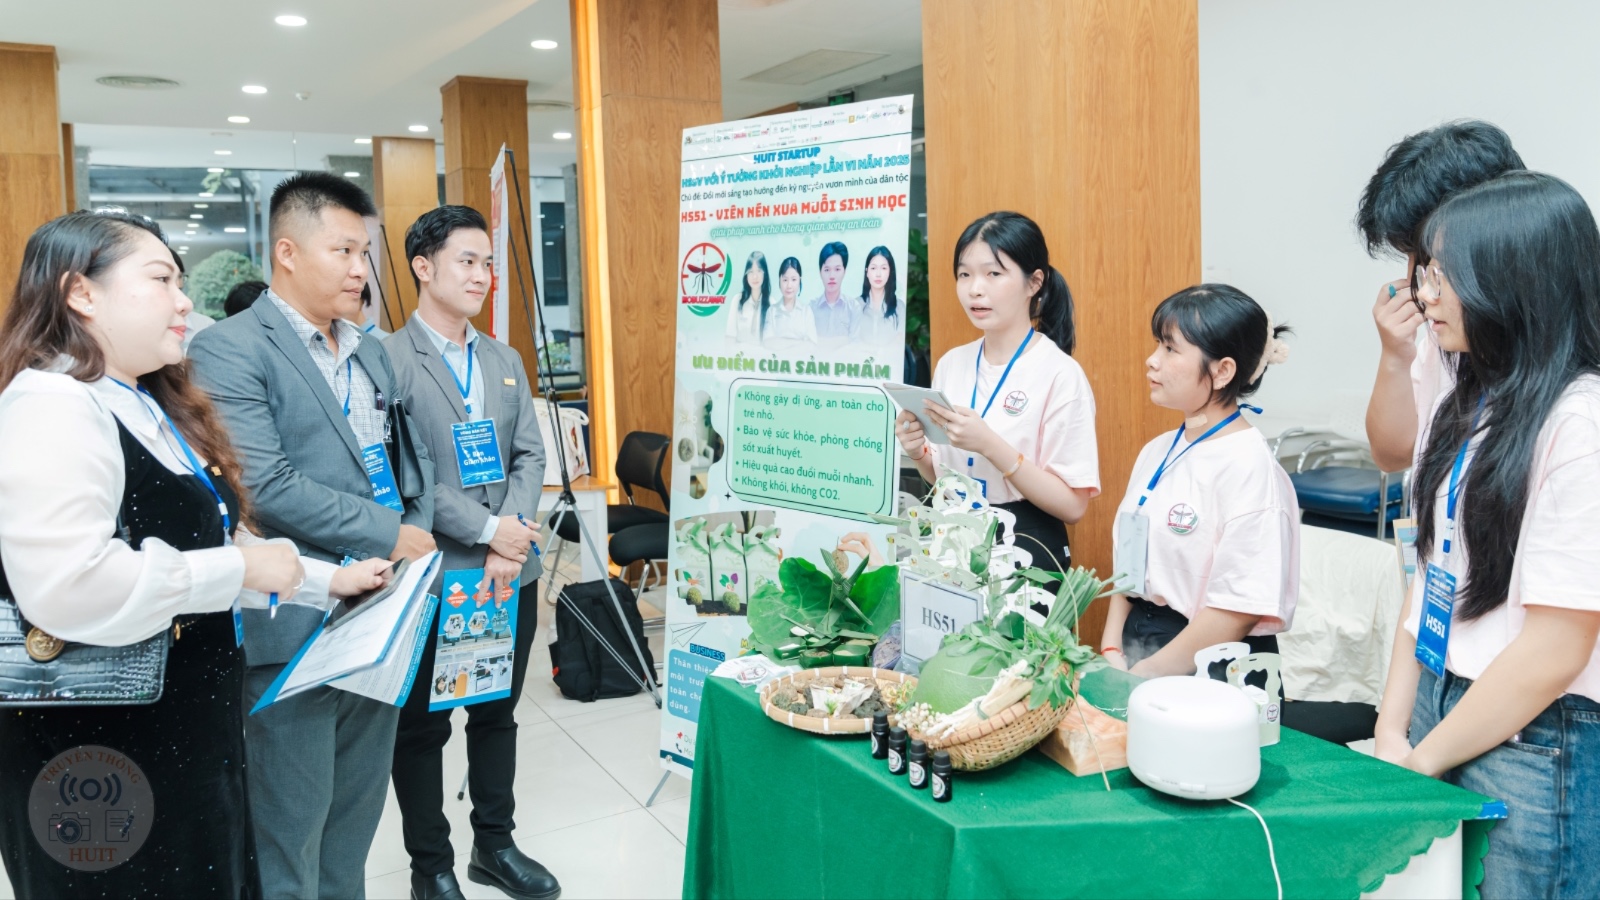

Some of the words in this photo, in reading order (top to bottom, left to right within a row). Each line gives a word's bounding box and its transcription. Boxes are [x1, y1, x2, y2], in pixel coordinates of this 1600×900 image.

[753, 152, 776, 164] HUIT
[778, 147, 821, 161] STARTUP
[704, 172, 719, 185] VỚI
[720, 170, 726, 184] Ý
[727, 168, 758, 183] TƯỞNG
[759, 164, 783, 180] KHỞI
[785, 161, 823, 178] NGHIỆP
[823, 155, 844, 173] LẦN
[845, 160, 857, 171] VI
[858, 154, 882, 170] NĂM
[884, 154, 910, 167] 2025
[703, 191, 714, 200] Đổi
[715, 190, 726, 198] mới
[728, 189, 741, 199] sáng
[743, 188, 752, 198] tạo
[753, 186, 773, 196] hướng
[775, 184, 787, 193] đến
[825, 180, 843, 189] vươn
[845, 177, 863, 187] mình
[865, 175, 878, 185] của
[879, 174, 893, 184] dân
[895, 173, 909, 184] tộc
[681, 210, 706, 223] HS51
[716, 204, 744, 220] VIÊN
[747, 202, 770, 218] NÉN
[773, 203, 798, 216] XUA
[801, 193, 836, 214] MUỖI
[839, 196, 874, 212] SINH
[878, 194, 906, 212] HỌC
[767, 223, 779, 233] cho
[807, 221, 825, 234] gian
[848, 221, 858, 229] an
[692, 354, 714, 369] ƯU
[717, 351, 755, 372] ĐIỂM
[759, 353, 791, 374] CỦA
[795, 355, 830, 376] SẢN
[834, 357, 890, 380] PHẨM
[744, 391, 770, 405] Không
[774, 393, 788, 406] gây
[792, 394, 800, 407] dị
[804, 395, 822, 409] ứng,
[826, 399, 837, 408] an
[841, 398, 862, 410] toàn
[866, 400, 884, 412] cho
[743, 408, 755, 418] trẻ
[757, 409, 775, 420] nhỏ.
[743, 424, 759, 436] Bảo
[763, 427, 772, 439] vệ
[776, 428, 790, 439] sức
[793, 429, 817, 443] khỏe,
[820, 432, 850, 449] phòng
[853, 436, 883, 453] chống
[742, 441, 755, 453] sốt
[757, 443, 775, 455] xuất
[776, 445, 802, 460] huyết.
[742, 459, 761, 471] Hiệu
[763, 463, 778, 475] quả
[780, 466, 795, 475] cao
[796, 465, 816, 479] đuổi
[817, 469, 841, 482] muỗi
[843, 473, 874, 487] nhanh.
[741, 475, 768, 492] Không
[769, 479, 789, 493] khói,
[791, 482, 818, 500] không
[819, 487, 841, 501] CO2.
[922, 607, 956, 633] HS51
[1426, 613, 1446, 639] HS51
[673, 657, 691, 669] Thân
[690, 643, 725, 662] BUSINESS
[670, 672, 684, 682] môi
[669, 686, 687, 698] toàn
[669, 700, 691, 714] dùng.
